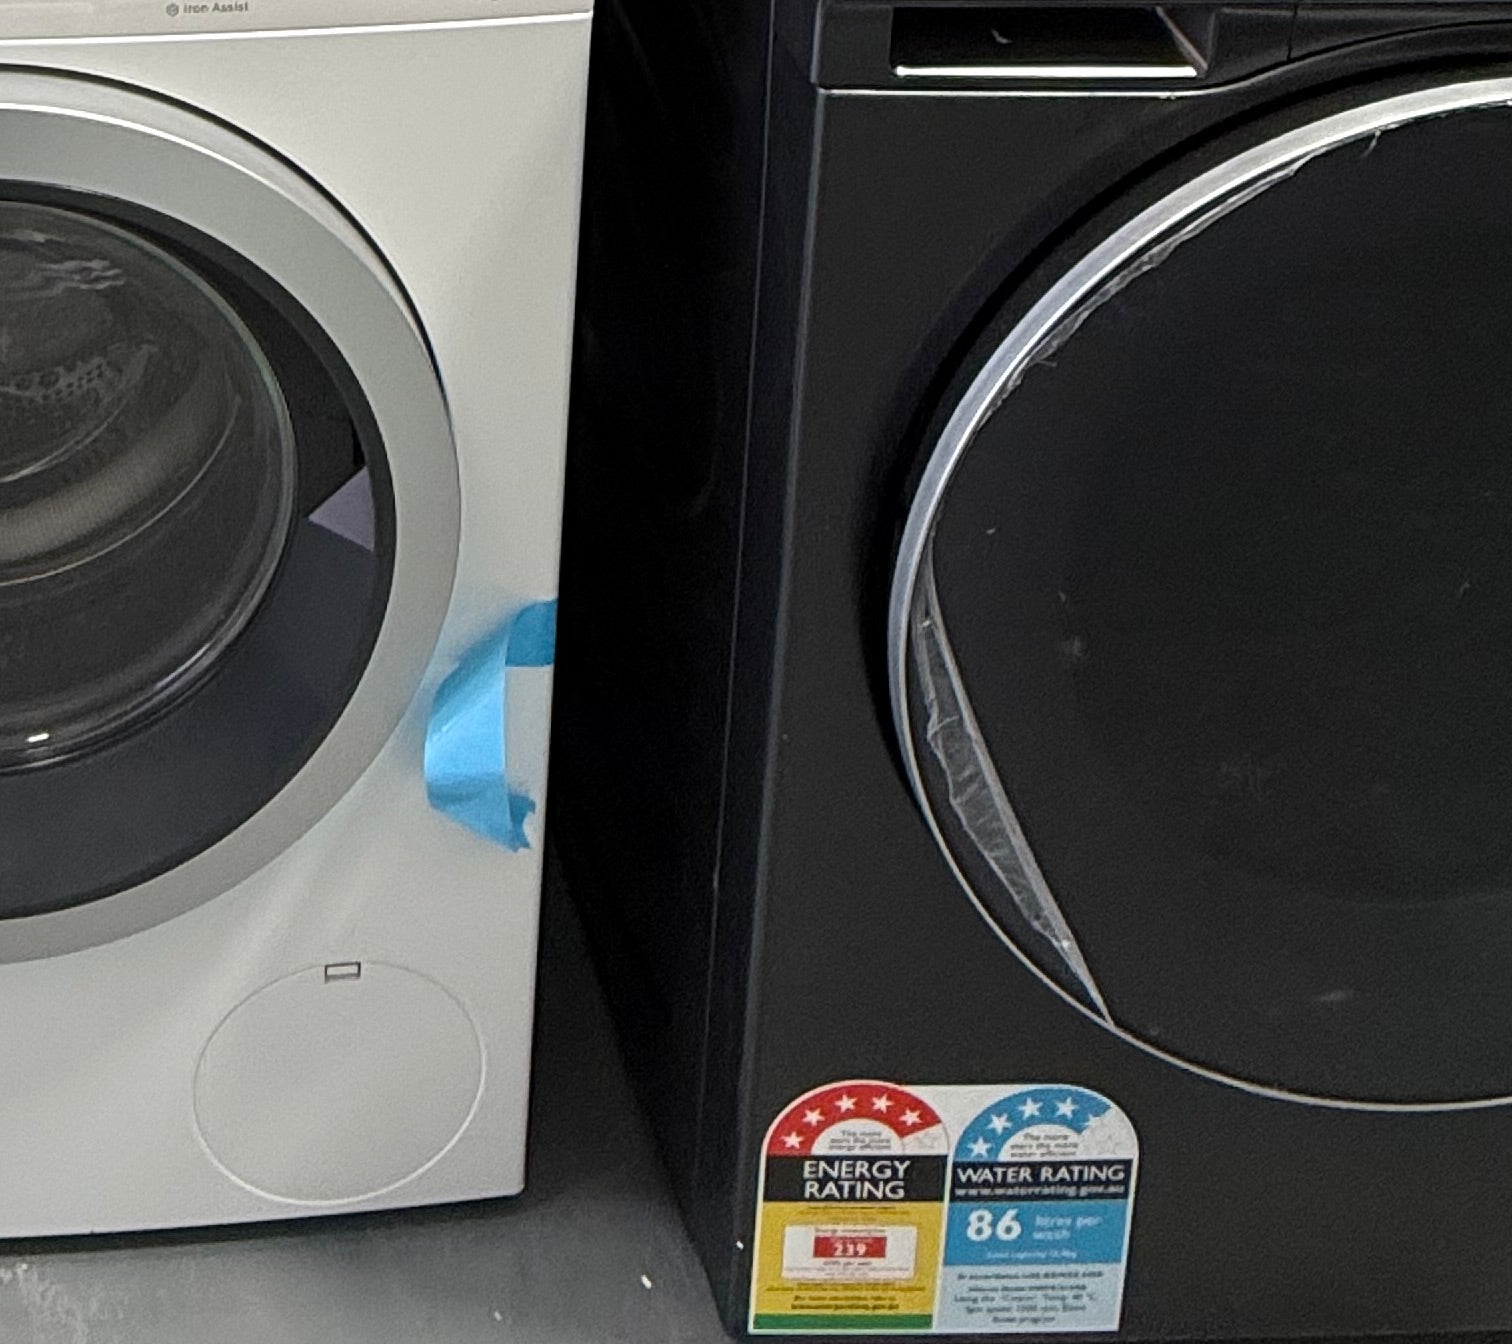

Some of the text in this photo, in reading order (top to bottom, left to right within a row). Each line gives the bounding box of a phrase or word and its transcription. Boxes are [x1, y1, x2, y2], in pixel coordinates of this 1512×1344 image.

[212, 1, 249, 13] Assist
[802, 1160, 912, 1180] ENERGY
[957, 1164, 1126, 1184] WATER RATING
[803, 1180, 906, 1200] RATING
[966, 1208, 1023, 1242] 86
